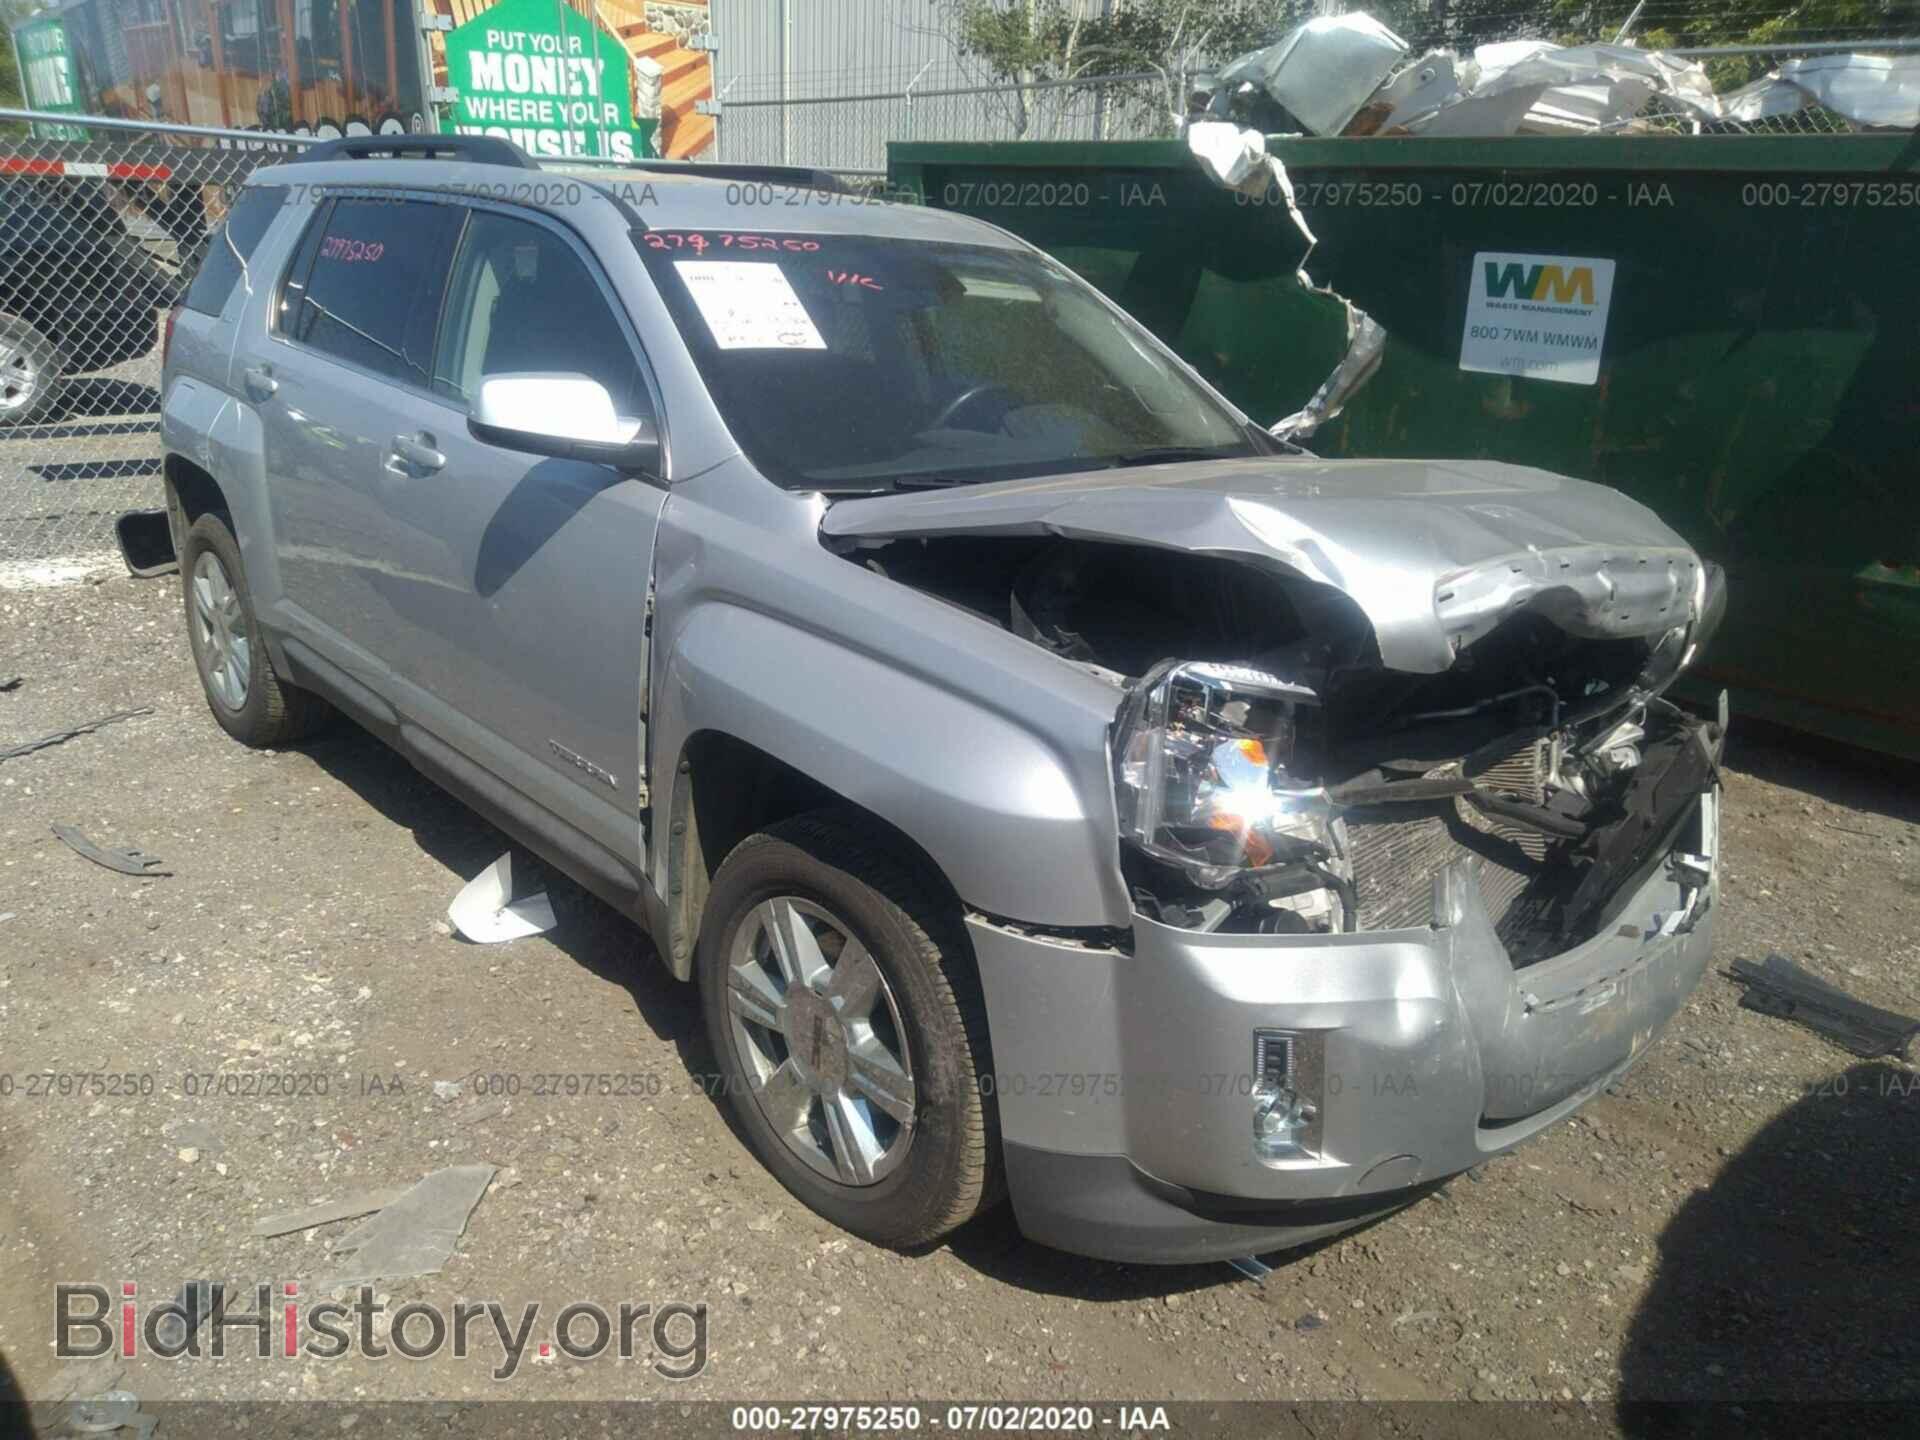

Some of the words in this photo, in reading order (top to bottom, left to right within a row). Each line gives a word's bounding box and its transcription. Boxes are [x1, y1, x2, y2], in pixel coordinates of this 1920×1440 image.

[487, 30, 525, 50] PUT
[529, 33, 582, 54] YOUR
[469, 51, 604, 97] MONEY
[464, 97, 554, 123] WHERE
[556, 101, 619, 125] YOUR
[455, 126, 587, 159] USE
[597, 130, 634, 163] IS
[1484, 262, 1595, 305] WM
[1470, 325, 1499, 341] 800
[1503, 327, 1539, 345] 7WM
[1543, 331, 1598, 351] WMWM
